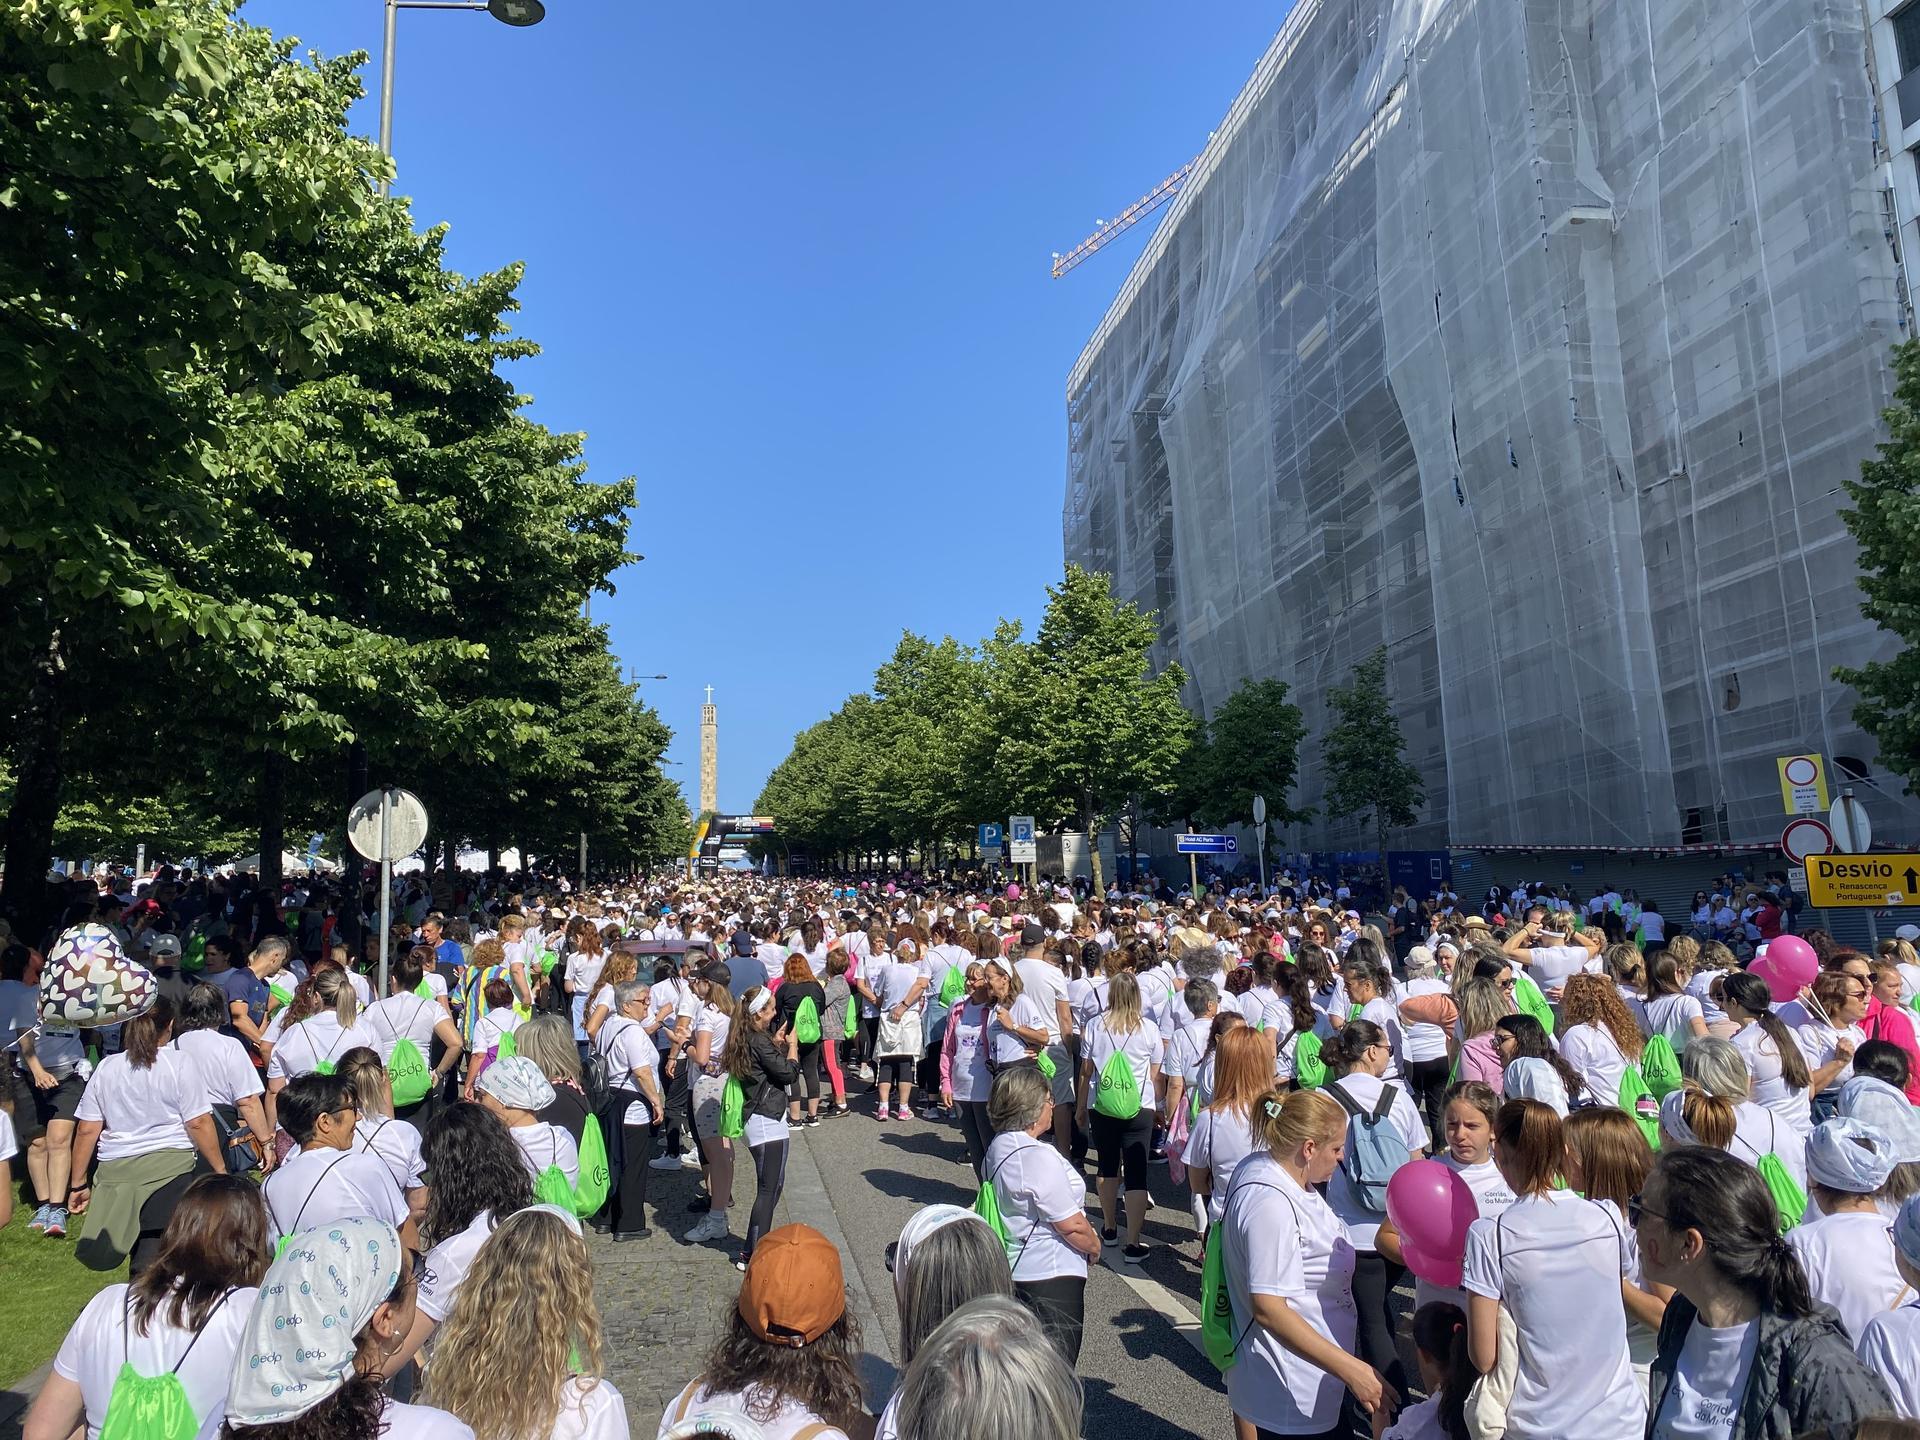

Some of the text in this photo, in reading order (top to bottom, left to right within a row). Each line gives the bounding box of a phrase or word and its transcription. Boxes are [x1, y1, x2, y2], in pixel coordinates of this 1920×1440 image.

[1818, 860, 1893, 878] Desvio
[1839, 882, 1888, 892] Renascença
[1836, 893, 1882, 901] Portuguesa
[398, 1061, 423, 1077] edp
[259, 1351, 282, 1365] edp
[304, 1349, 327, 1360] edp
[285, 1381, 308, 1393] edp
[1700, 1398, 1730, 1416] Corrid
